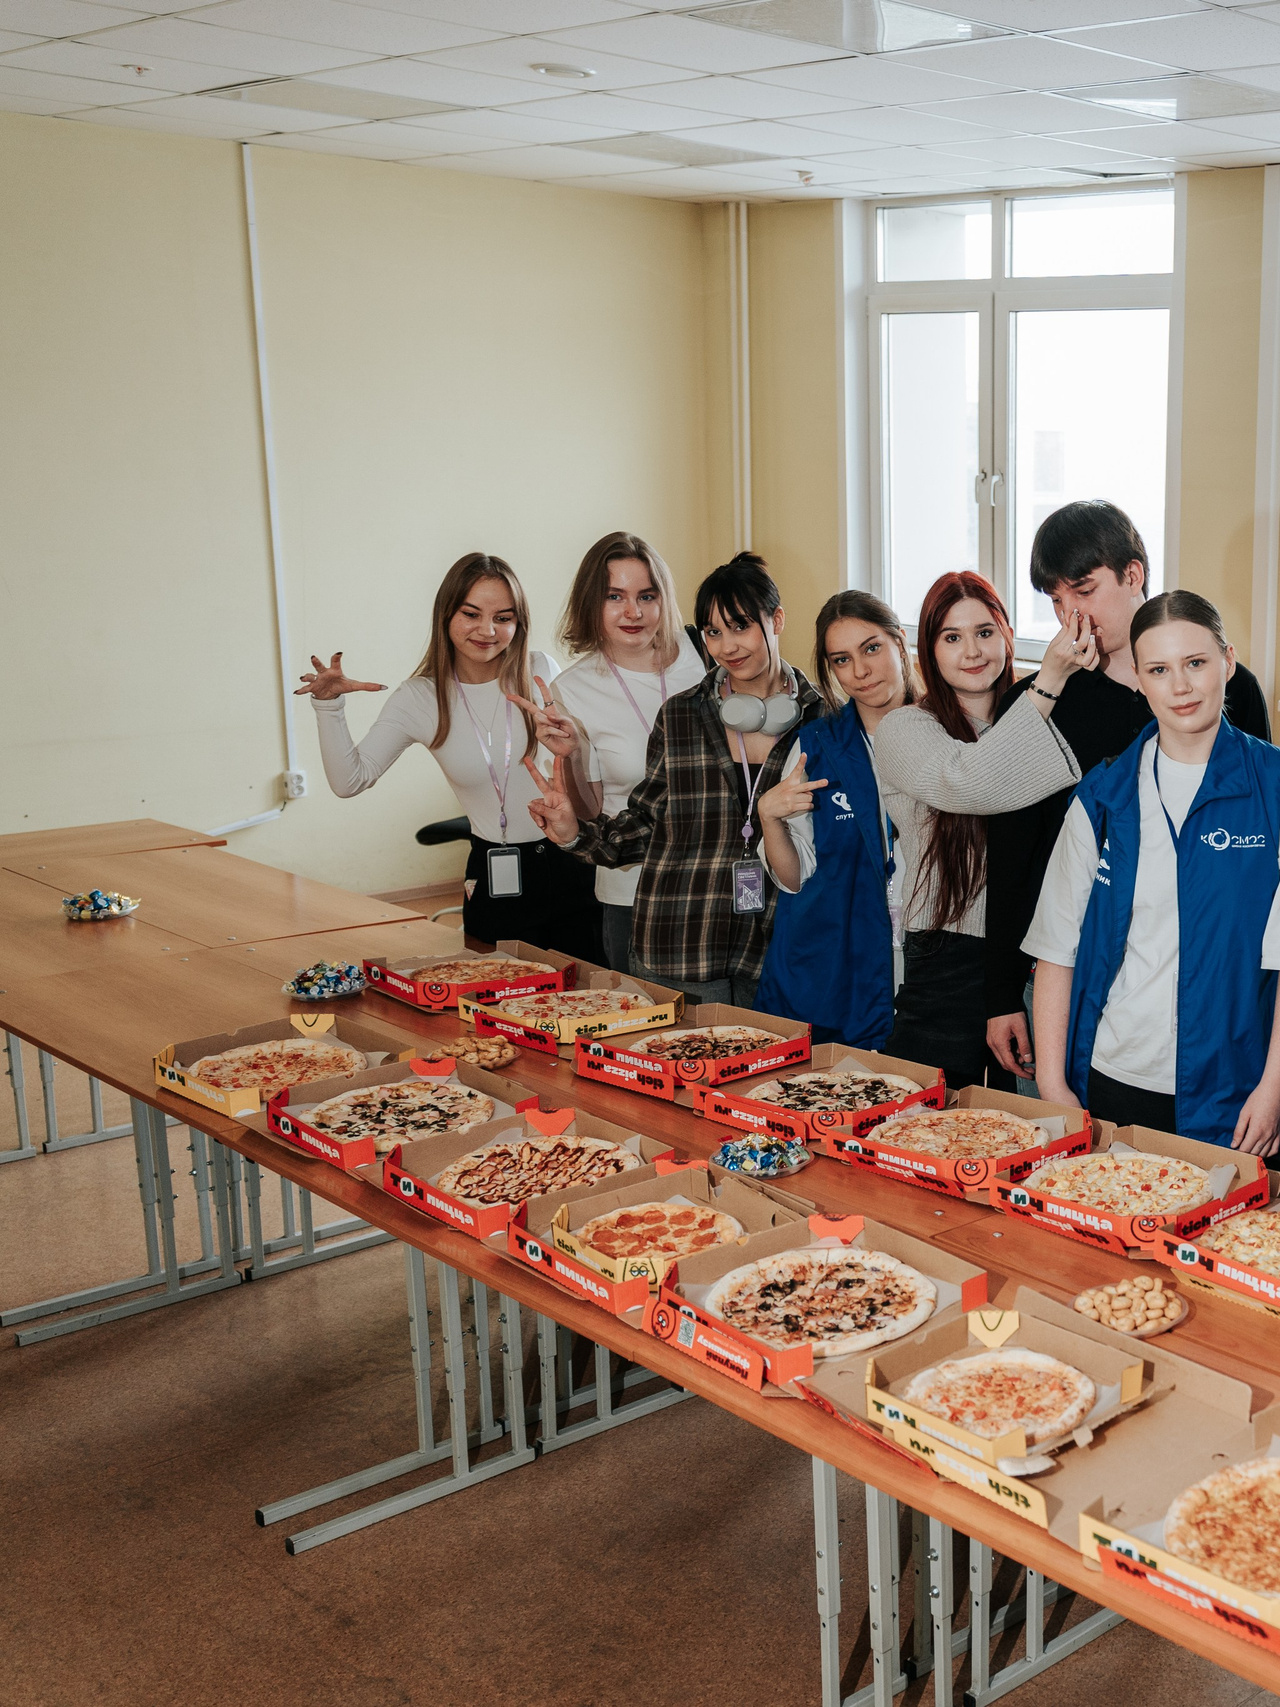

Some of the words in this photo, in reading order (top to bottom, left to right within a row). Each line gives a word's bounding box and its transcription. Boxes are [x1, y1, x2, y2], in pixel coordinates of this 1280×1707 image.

[476, 982, 557, 1000] chpizza.ru
[575, 1013, 668, 1036] tichpizza.ru
[587, 1060, 665, 1091] tichpizza.ru
[719, 1050, 804, 1078] tichpizza.ru
[714, 1104, 796, 1138] tichpizza.ru
[301, 1131, 341, 1160] пицца
[1009, 1142, 1087, 1176] ichpizza.ru
[426, 1193, 475, 1227] пицца
[1046, 1202, 1113, 1232] пицца
[1181, 1192, 1264, 1237] tichpizza.ru
[555, 1261, 610, 1300] пицца
